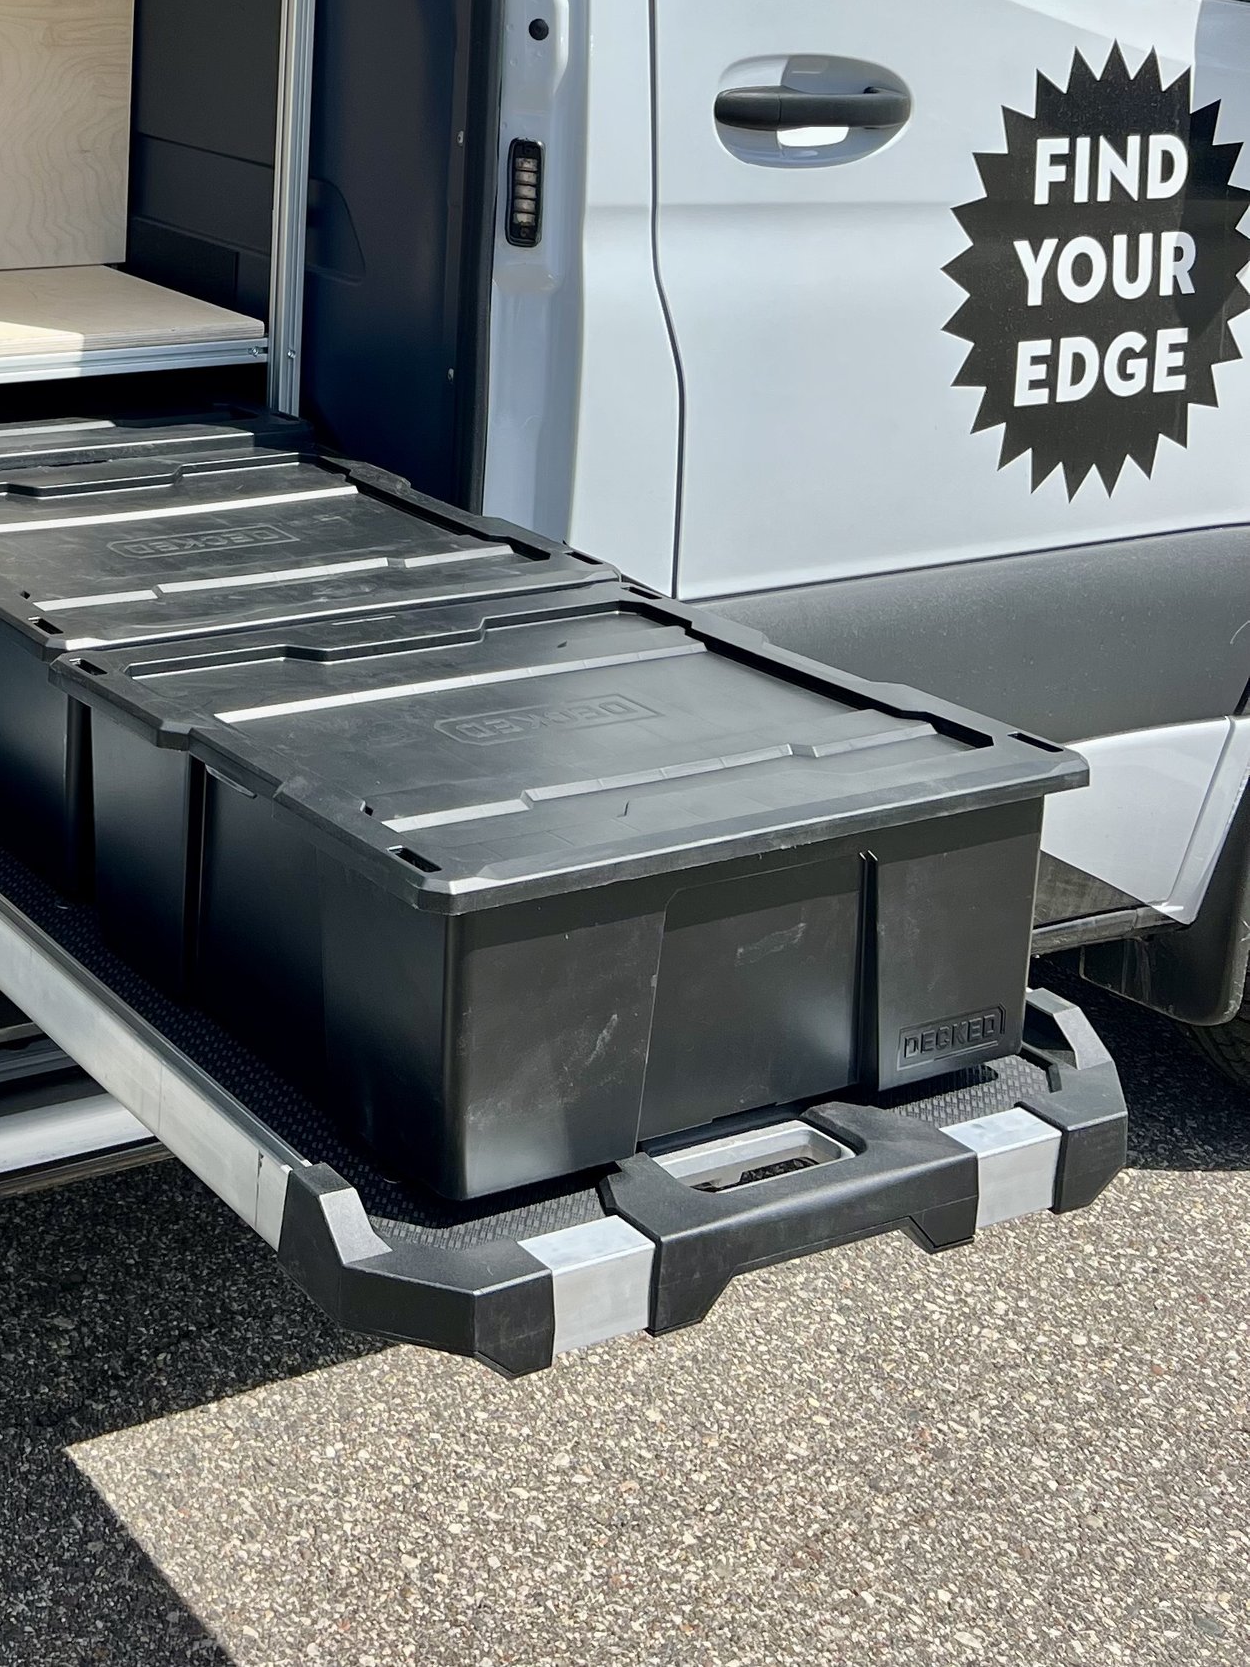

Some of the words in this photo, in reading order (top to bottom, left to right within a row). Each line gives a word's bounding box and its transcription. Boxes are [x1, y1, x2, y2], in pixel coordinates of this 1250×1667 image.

[1033, 133, 1190, 205] FIND
[1013, 231, 1197, 307] YOUR
[1013, 327, 1190, 408] EDGE
[904, 1014, 996, 1058] DECKED
